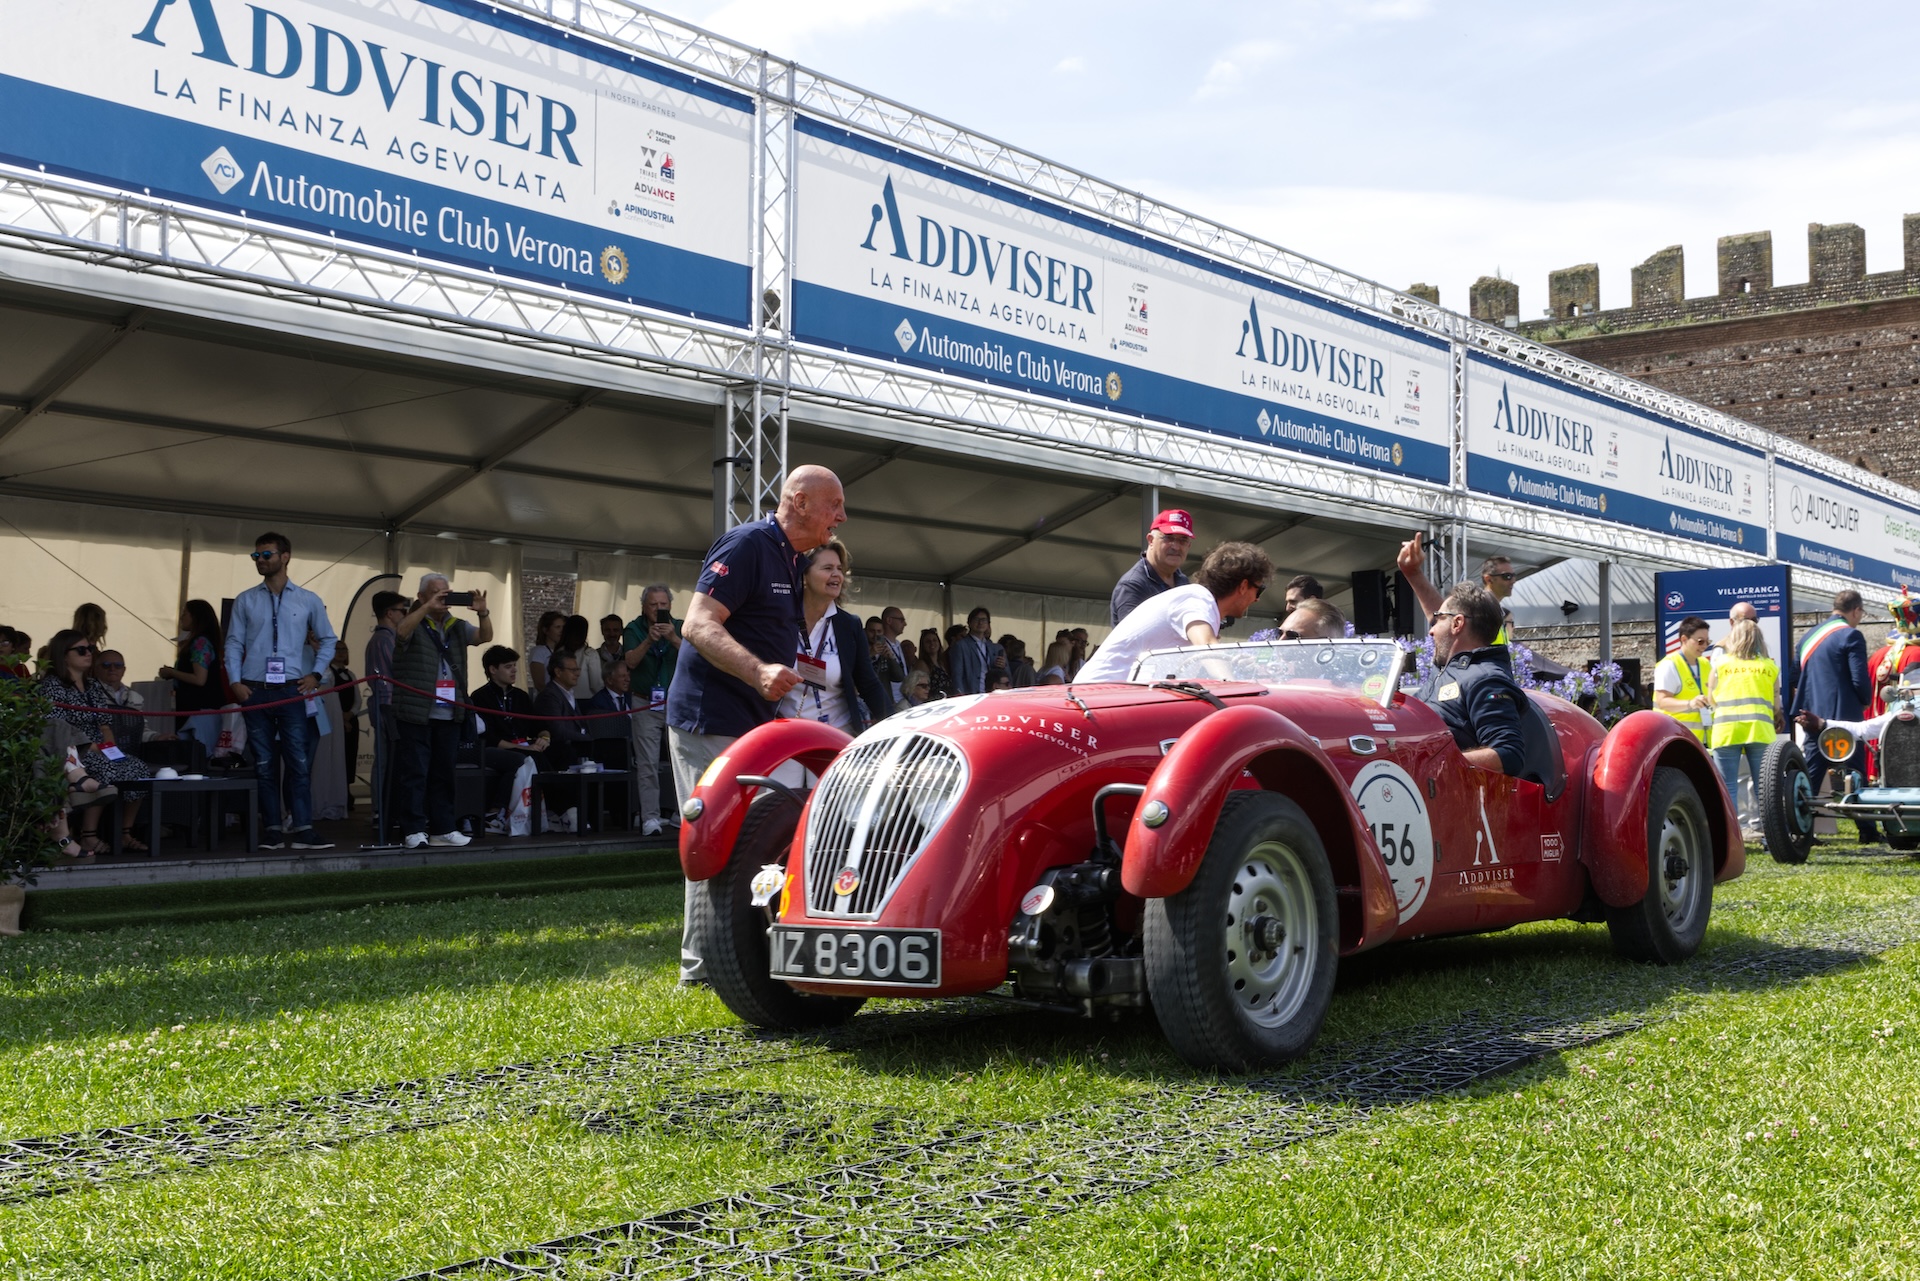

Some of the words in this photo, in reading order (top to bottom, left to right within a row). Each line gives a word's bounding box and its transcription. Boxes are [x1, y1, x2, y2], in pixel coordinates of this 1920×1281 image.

[131, 0, 583, 167] ADDVISER
[611, 92, 639, 107] NOSTRI
[642, 101, 677, 119] PARTNER
[154, 69, 196, 104] LA
[219, 87, 369, 150] FINANZA
[386, 136, 566, 203] AGEVOLATA
[655, 129, 676, 141] PARTNER
[213, 163, 236, 179] ACI
[634, 182, 676, 202] ADVANCE
[249, 161, 430, 236] Automobile
[438, 206, 500, 253] Club
[505, 222, 594, 276] Verona
[624, 203, 675, 225] APINDUSTRIA
[860, 173, 1097, 315] ADDVISER
[870, 267, 893, 290] LA
[903, 276, 981, 313] FINANZA
[989, 302, 1088, 343] AGEVOLATA
[901, 331, 912, 341] ACI
[1124, 323, 1149, 336] ADVANCE
[918, 326, 1013, 373] Automobile
[1017, 350, 1051, 383] Club
[1053, 359, 1103, 396] Verona
[1119, 340, 1148, 352] APINDUSTRIA
[1235, 296, 1386, 397] ADDVISER
[1242, 370, 1256, 385] LA
[1262, 376, 1312, 401] FINANZA
[1316, 391, 1380, 420] AGEVOLATA
[1493, 380, 1595, 456] ADDVISER
[1272, 413, 1332, 449] Automobile
[1333, 429, 1356, 455] Club
[1357, 435, 1391, 463] Verona
[1497, 439, 1508, 453] LA
[1510, 443, 1545, 463] FINANZA
[1547, 455, 1591, 475] AGEVOLATA
[1658, 433, 1734, 496] ADDVISER
[1518, 474, 1559, 501] Automobile
[1559, 484, 1575, 505] Club
[1575, 488, 1598, 510] Verona
[1671, 487, 1697, 503] FINANZA
[1699, 496, 1732, 512] AGEVOLATA
[1677, 514, 1707, 535] Automobile
[1707, 521, 1720, 539] Club
[1720, 524, 1738, 542] Verona
[1806, 493, 1859, 533] AUTOSILVER
[1884, 515, 1904, 538] Green
[1717, 586, 1780, 595] VILLAFRANCA
[1724, 667, 1773, 678] MARSHAL
[943, 714, 1098, 750] ADDVISER
[969, 725, 1023, 734] FINANZA
[1028, 729, 1089, 759] AGEVOLATA
[1825, 738, 1850, 759] 19
[1543, 838, 1559, 847] 1000
[1543, 849, 1560, 858] MIGLIA
[1459, 868, 1515, 885] ADDVISER
[815, 933, 930, 980] 8306
